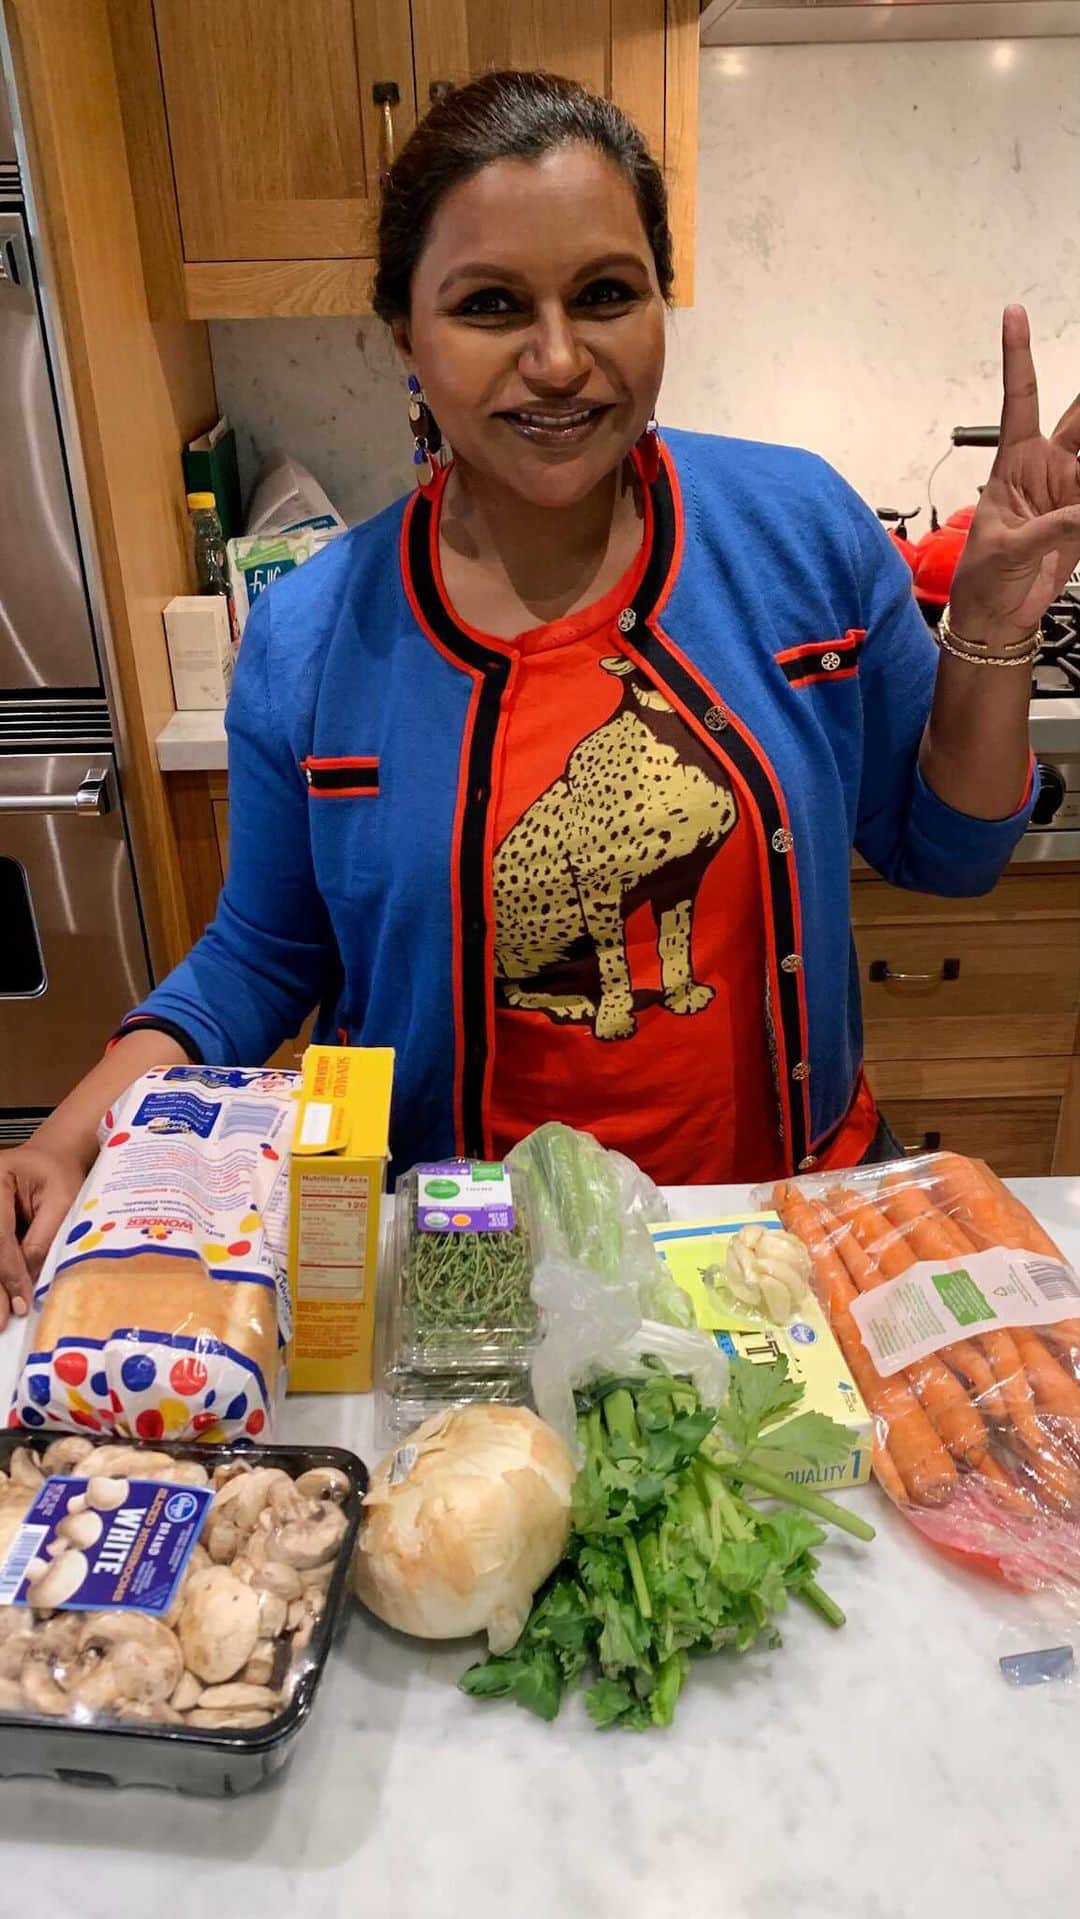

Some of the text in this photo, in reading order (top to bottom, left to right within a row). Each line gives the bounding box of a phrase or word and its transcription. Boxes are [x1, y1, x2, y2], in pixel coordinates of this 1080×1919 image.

[127, 1217, 193, 1231] WONDER
[851, 1449, 862, 1479] 1
[92, 1507, 148, 1575] WHITE
[148, 1522, 172, 1556] BRAND
